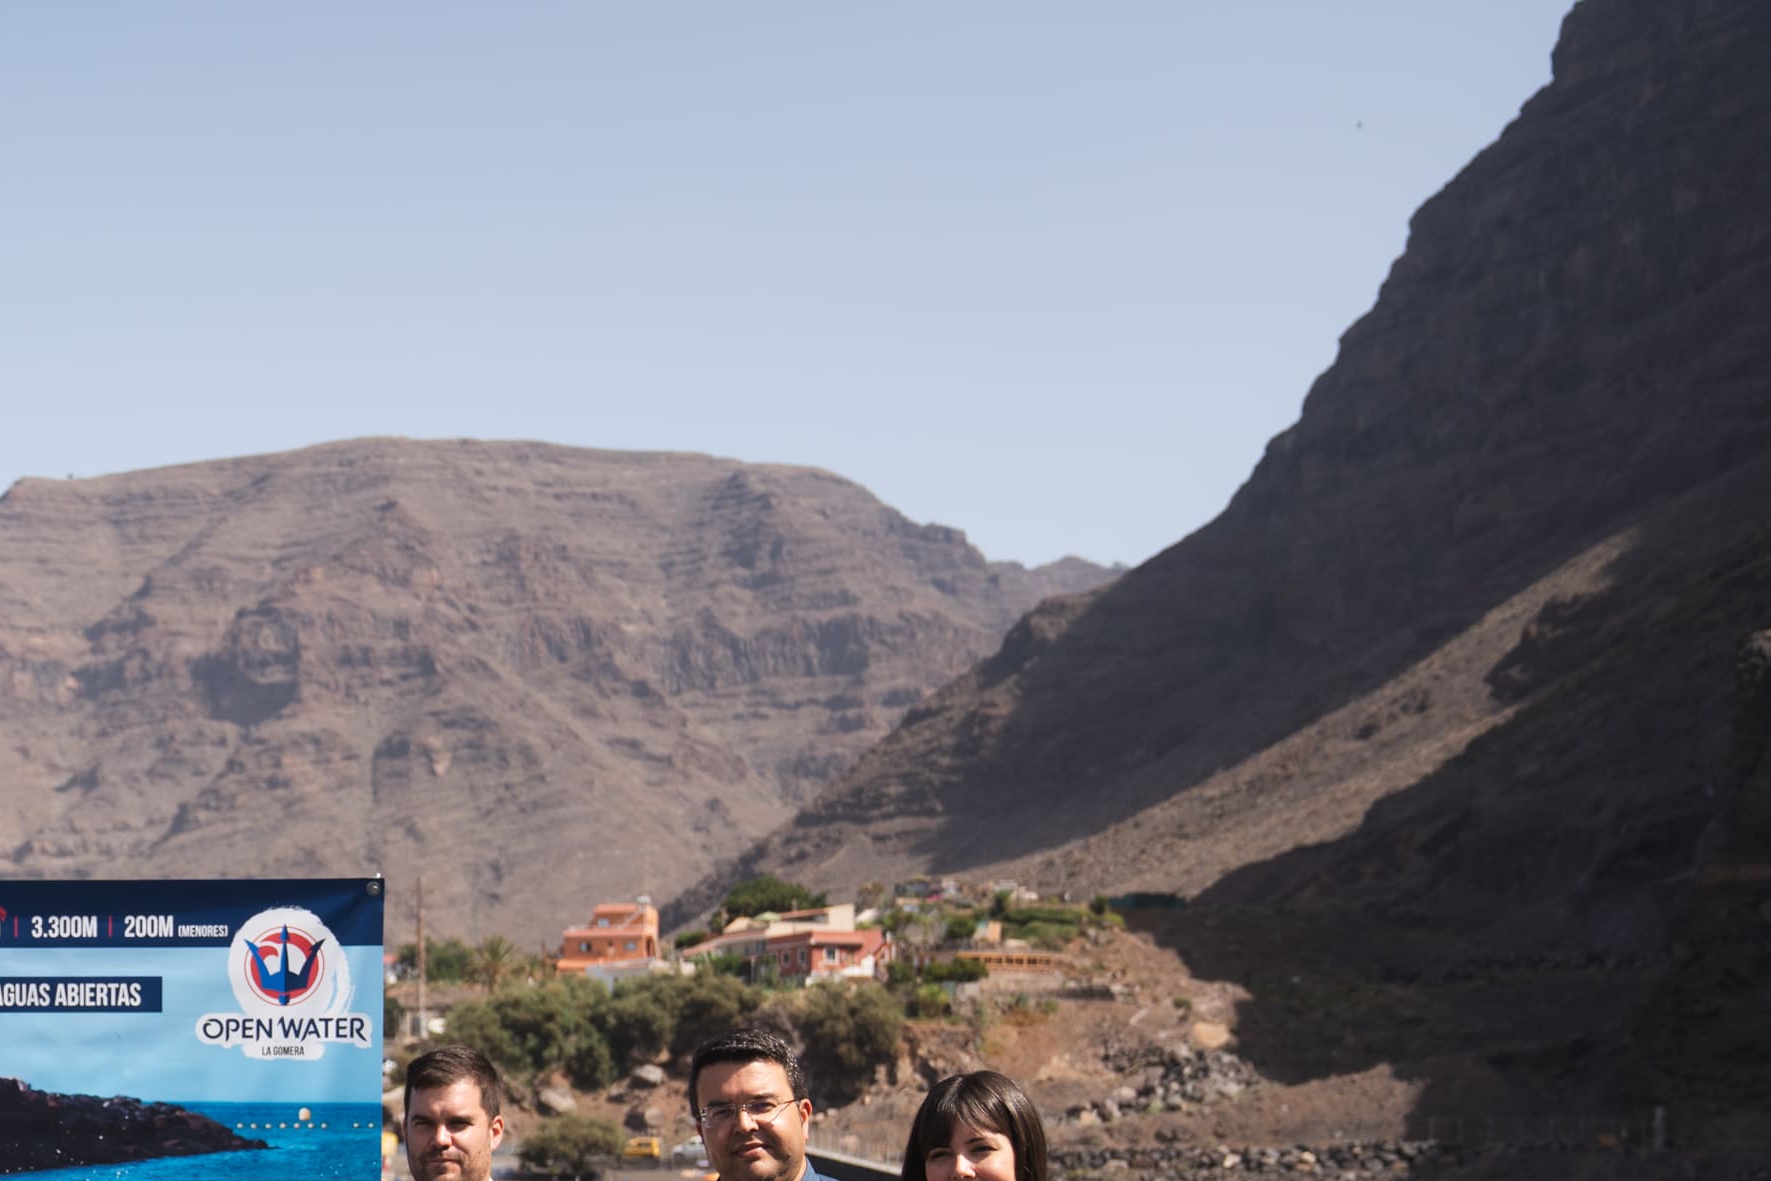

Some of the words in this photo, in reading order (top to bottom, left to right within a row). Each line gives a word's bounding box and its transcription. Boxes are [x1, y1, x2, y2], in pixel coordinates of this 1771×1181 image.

[31, 915, 98, 938] 3.300M
[124, 915, 174, 937] 200M
[54, 982, 142, 1007] ABIERTAS
[202, 1018, 273, 1042] OPEN
[278, 1016, 367, 1042] WATER
[261, 1046, 272, 1056] LA
[273, 1046, 305, 1056] GOMERA
